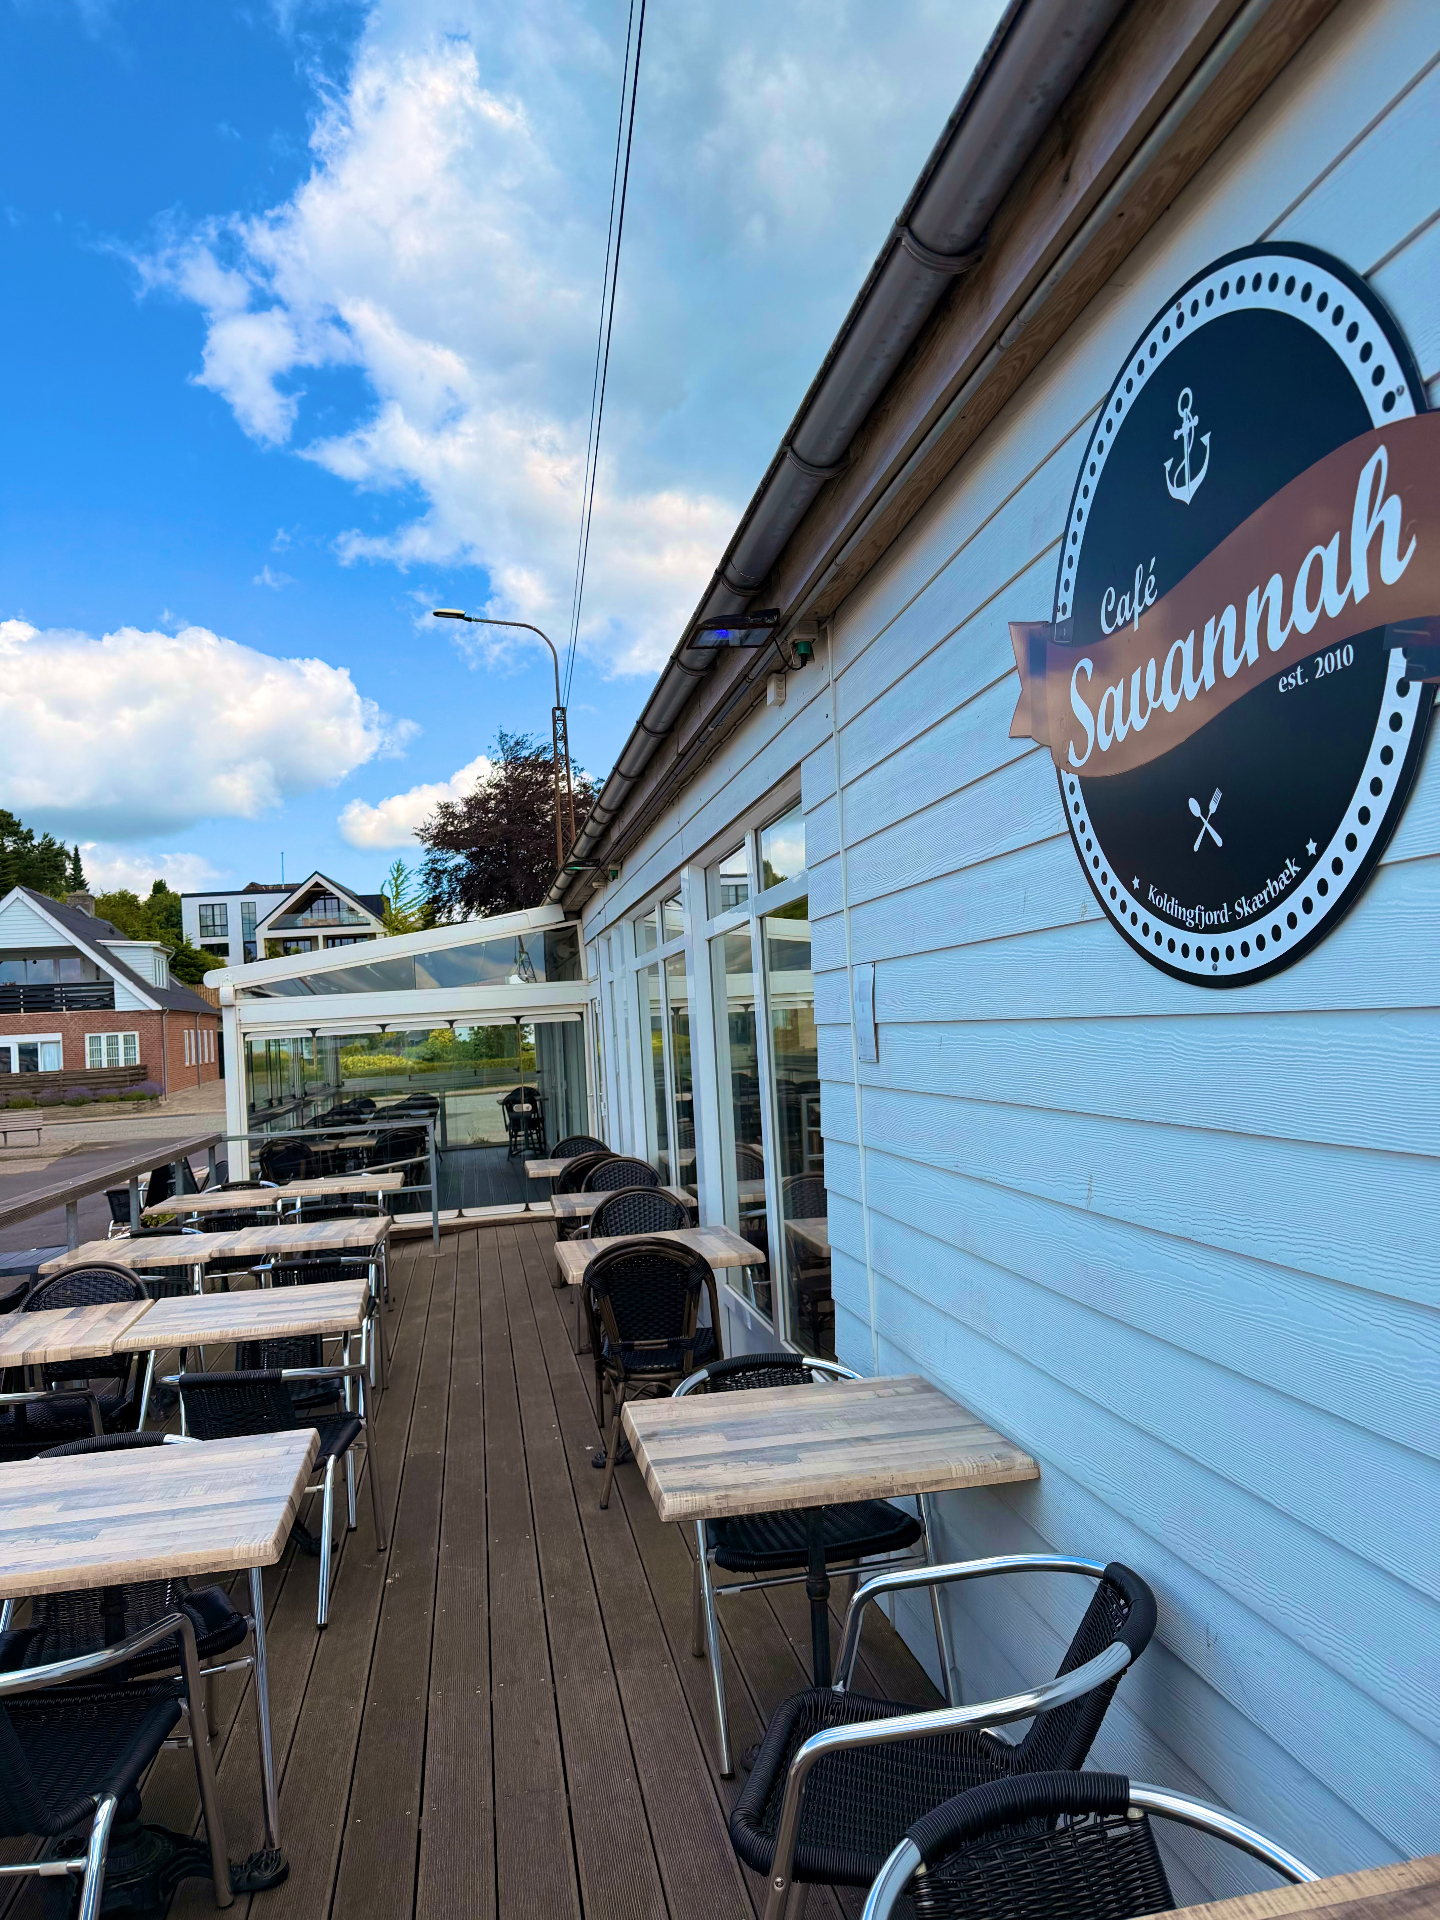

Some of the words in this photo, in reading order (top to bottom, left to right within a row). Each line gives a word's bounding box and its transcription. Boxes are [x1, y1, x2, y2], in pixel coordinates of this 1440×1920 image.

[1068, 444, 1417, 768] Savannah
[1100, 556, 1158, 635] Café
[1278, 665, 1309, 693] est.
[1313, 644, 1354, 680] 2010
[1234, 857, 1302, 921] Skærbæk
